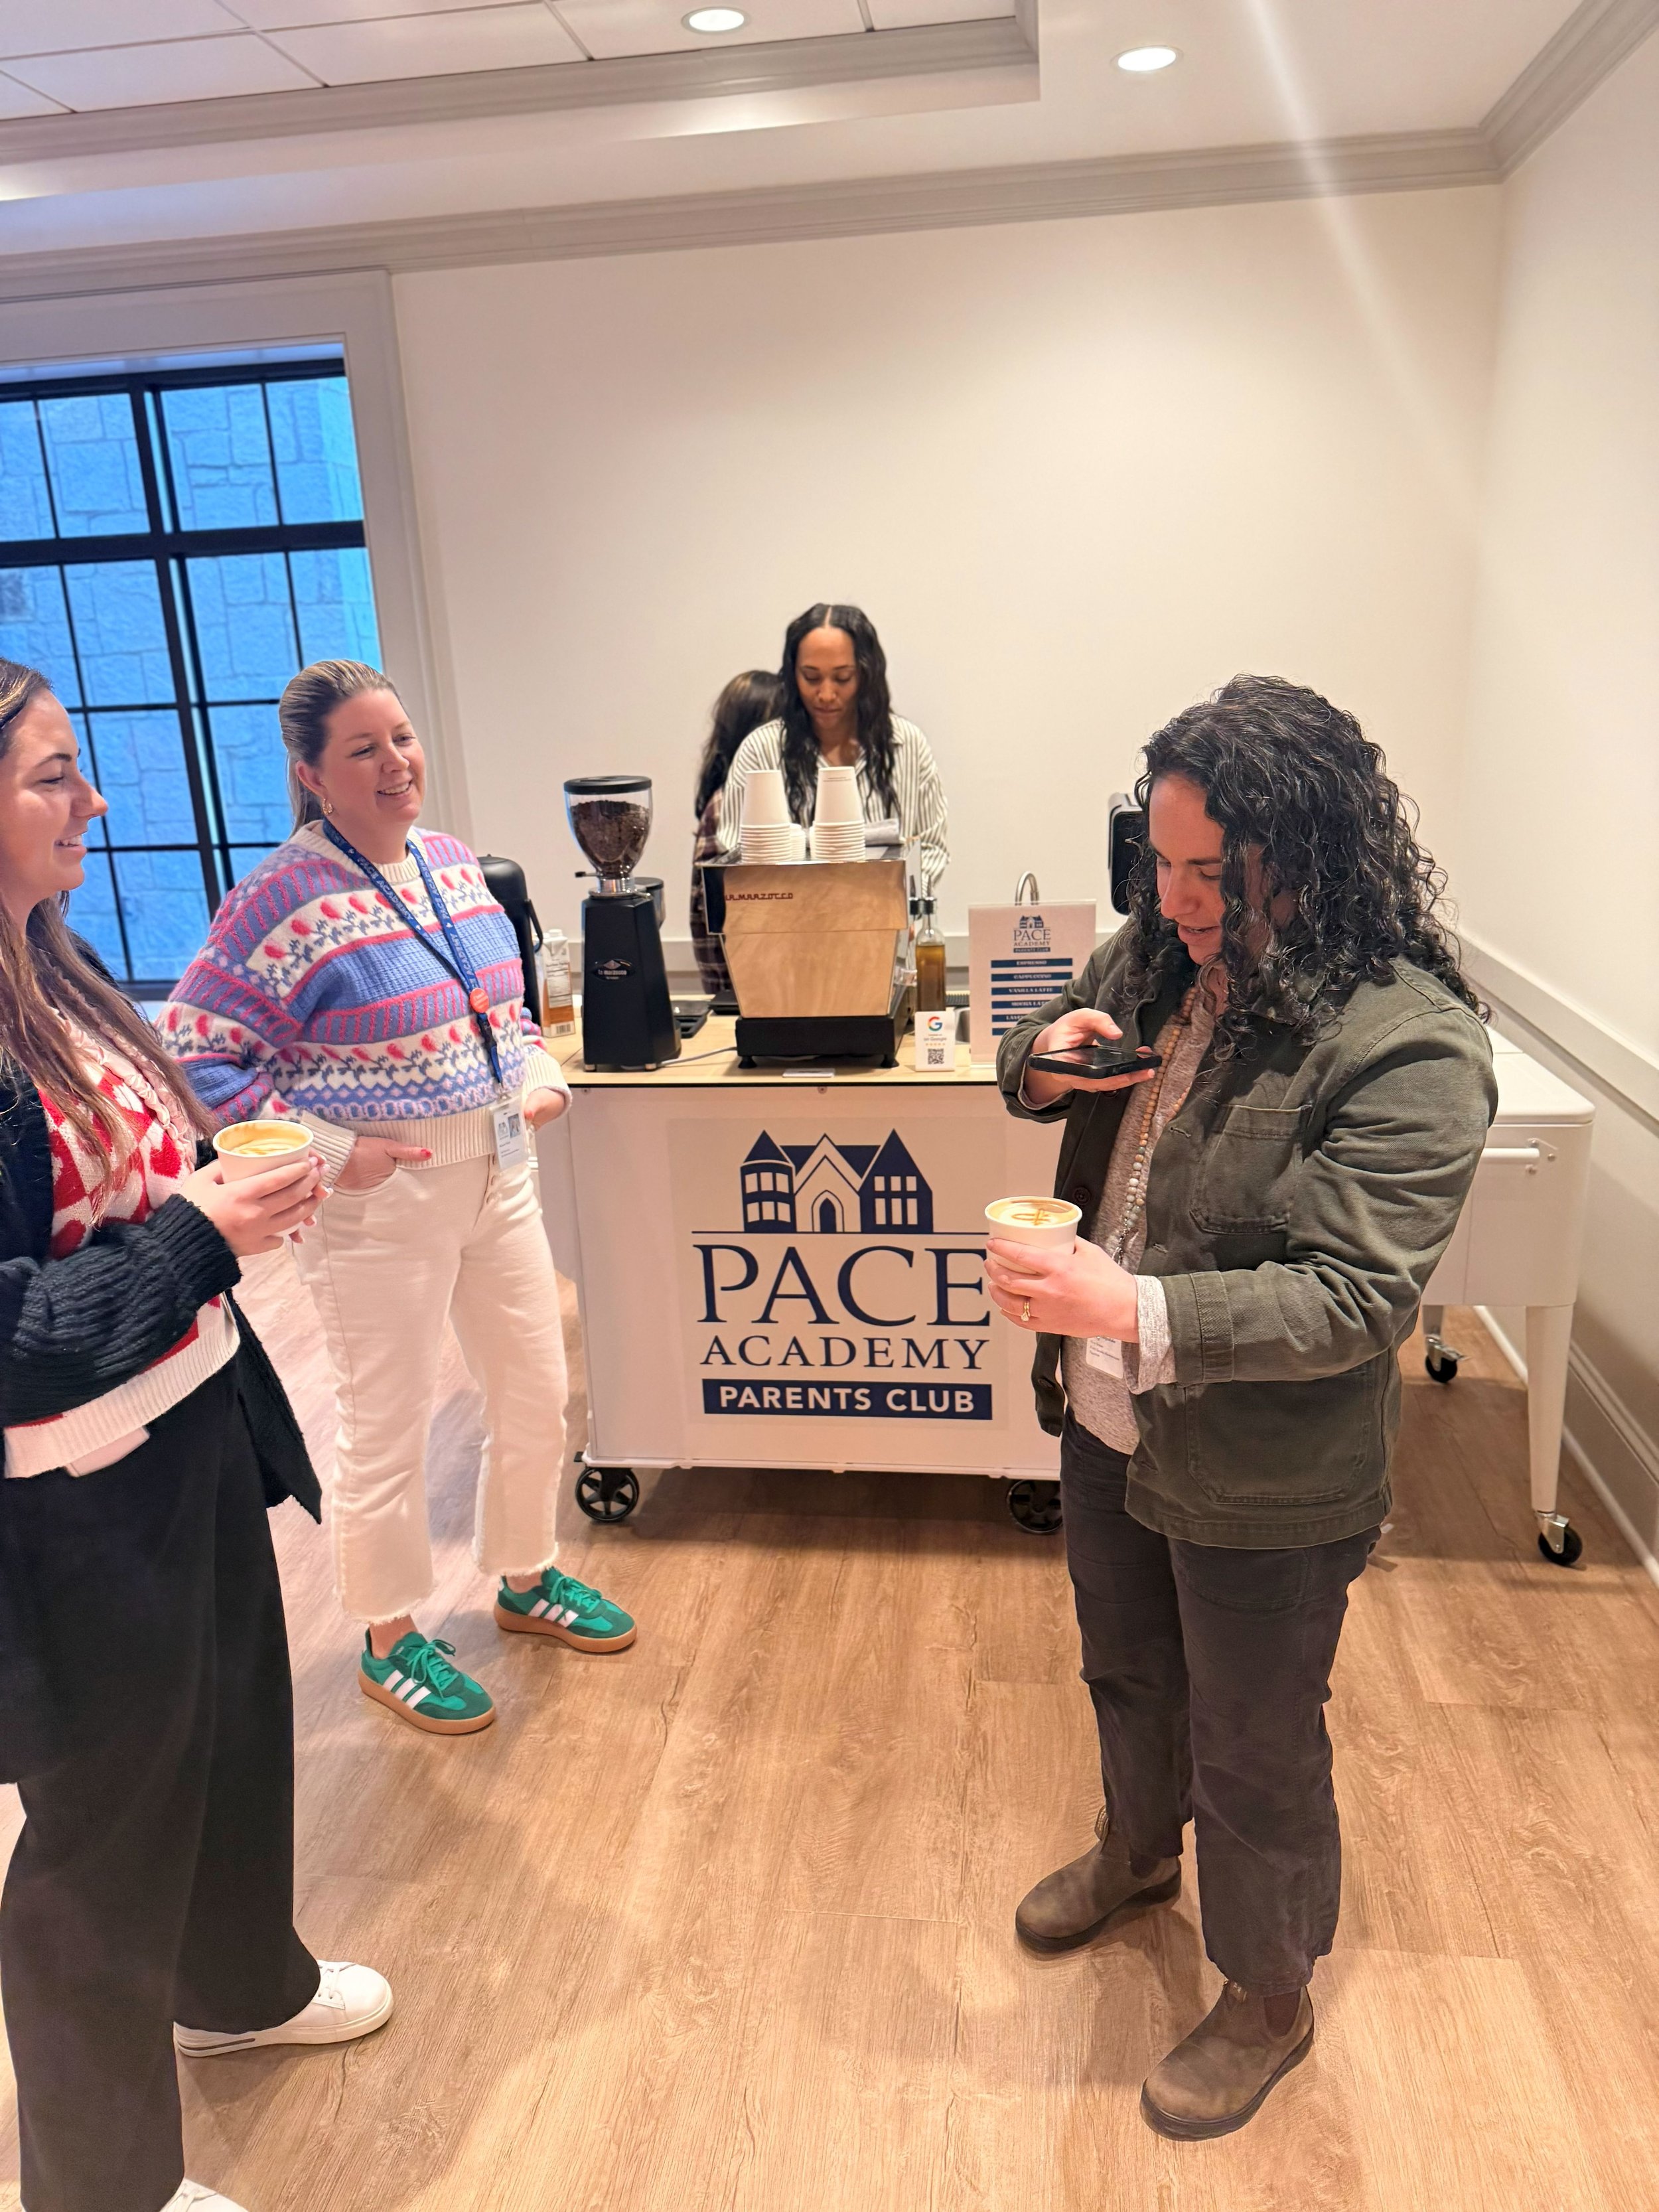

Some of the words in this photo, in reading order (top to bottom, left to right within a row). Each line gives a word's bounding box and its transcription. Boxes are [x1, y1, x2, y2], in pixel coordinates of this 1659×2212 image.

[376, 880, 414, 921] ACADEMY
[1013, 928, 1051, 941] PACE
[692, 1244, 991, 1327] PACE
[699, 1335, 990, 1370] ACADEMY
[719, 1386, 872, 1410] PARENTS
[885, 1388, 975, 1413] CLUB
